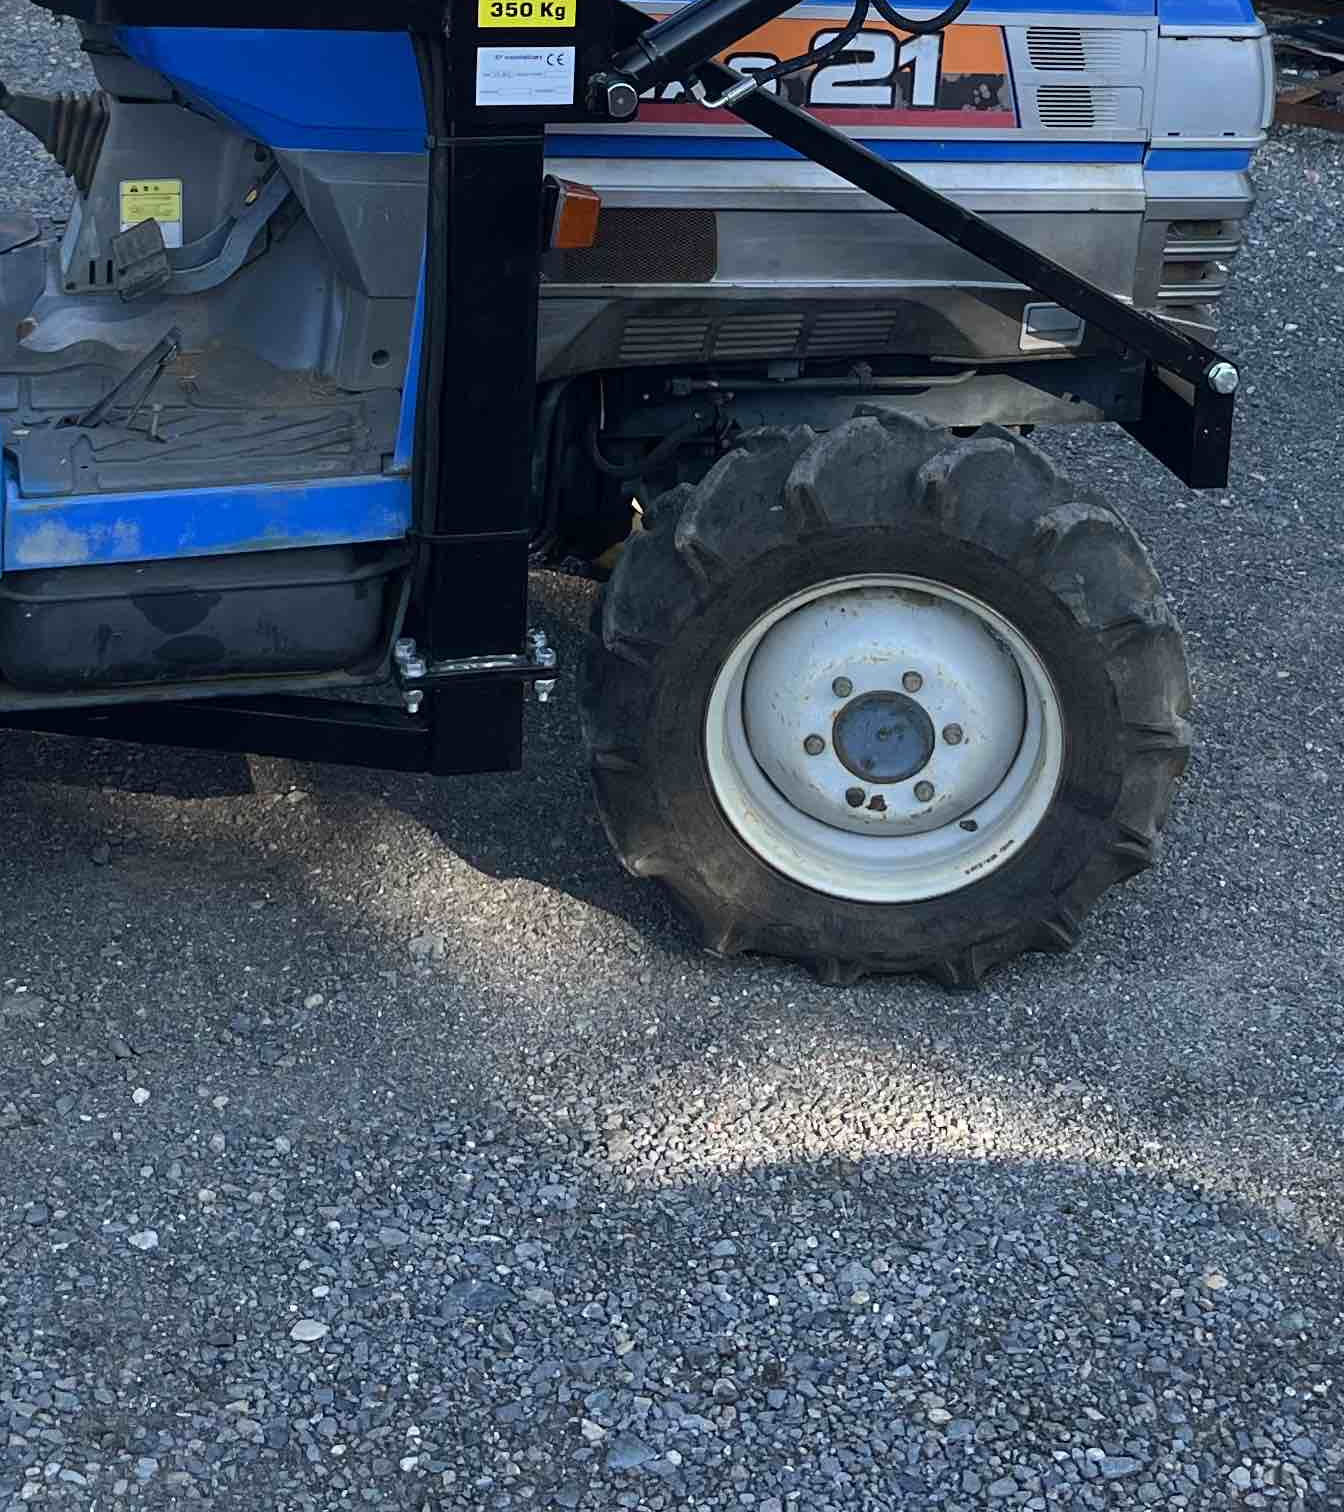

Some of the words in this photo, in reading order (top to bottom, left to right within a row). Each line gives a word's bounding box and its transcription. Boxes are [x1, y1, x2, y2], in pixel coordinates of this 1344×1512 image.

[490, 2, 533, 18] 350
[540, 2, 566, 21] Kg
[546, 53, 566, 66] CE
[806, 27, 944, 108] 21
